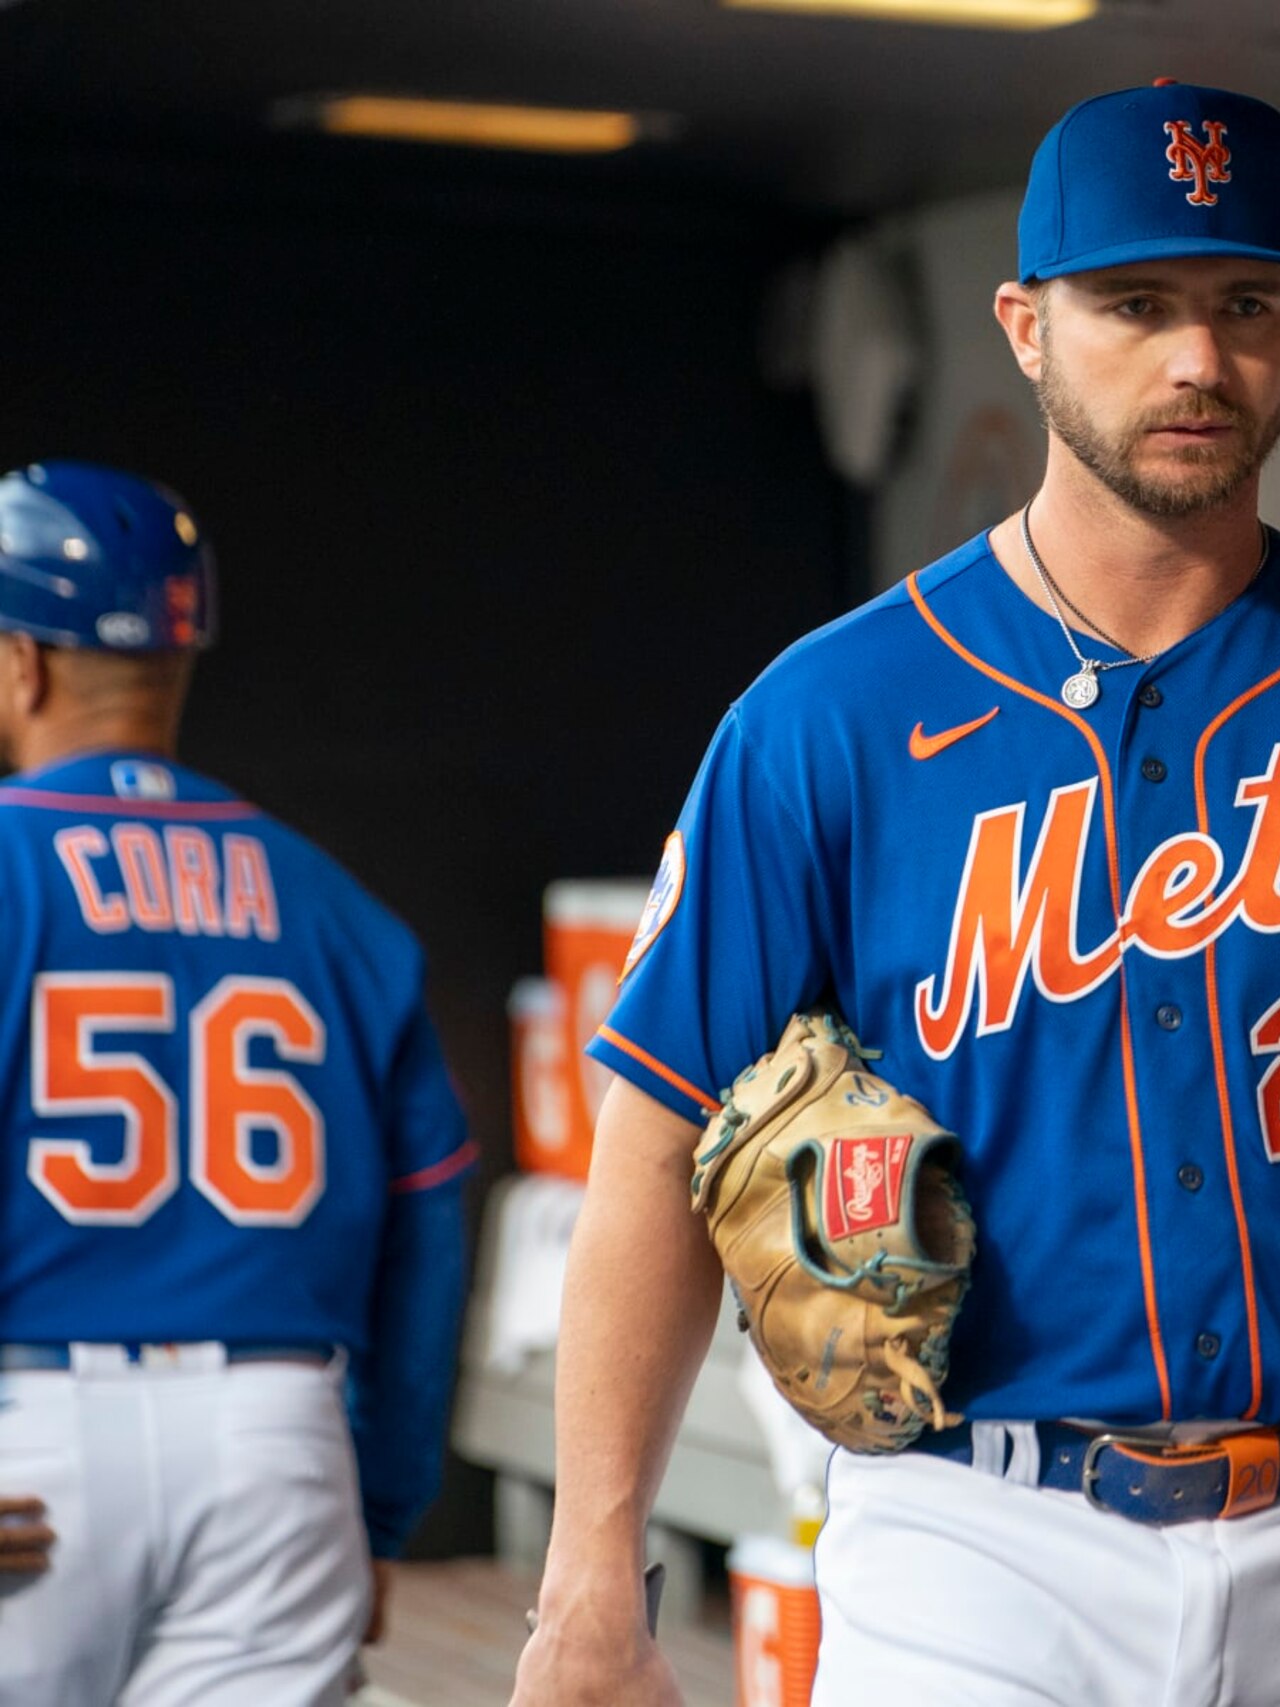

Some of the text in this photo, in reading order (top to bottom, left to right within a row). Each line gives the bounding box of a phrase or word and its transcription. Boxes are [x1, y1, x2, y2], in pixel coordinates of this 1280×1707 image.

[54, 823, 280, 942] CORA
[26, 971, 325, 1227] 56
[1236, 1459, 1278, 1500] 20
